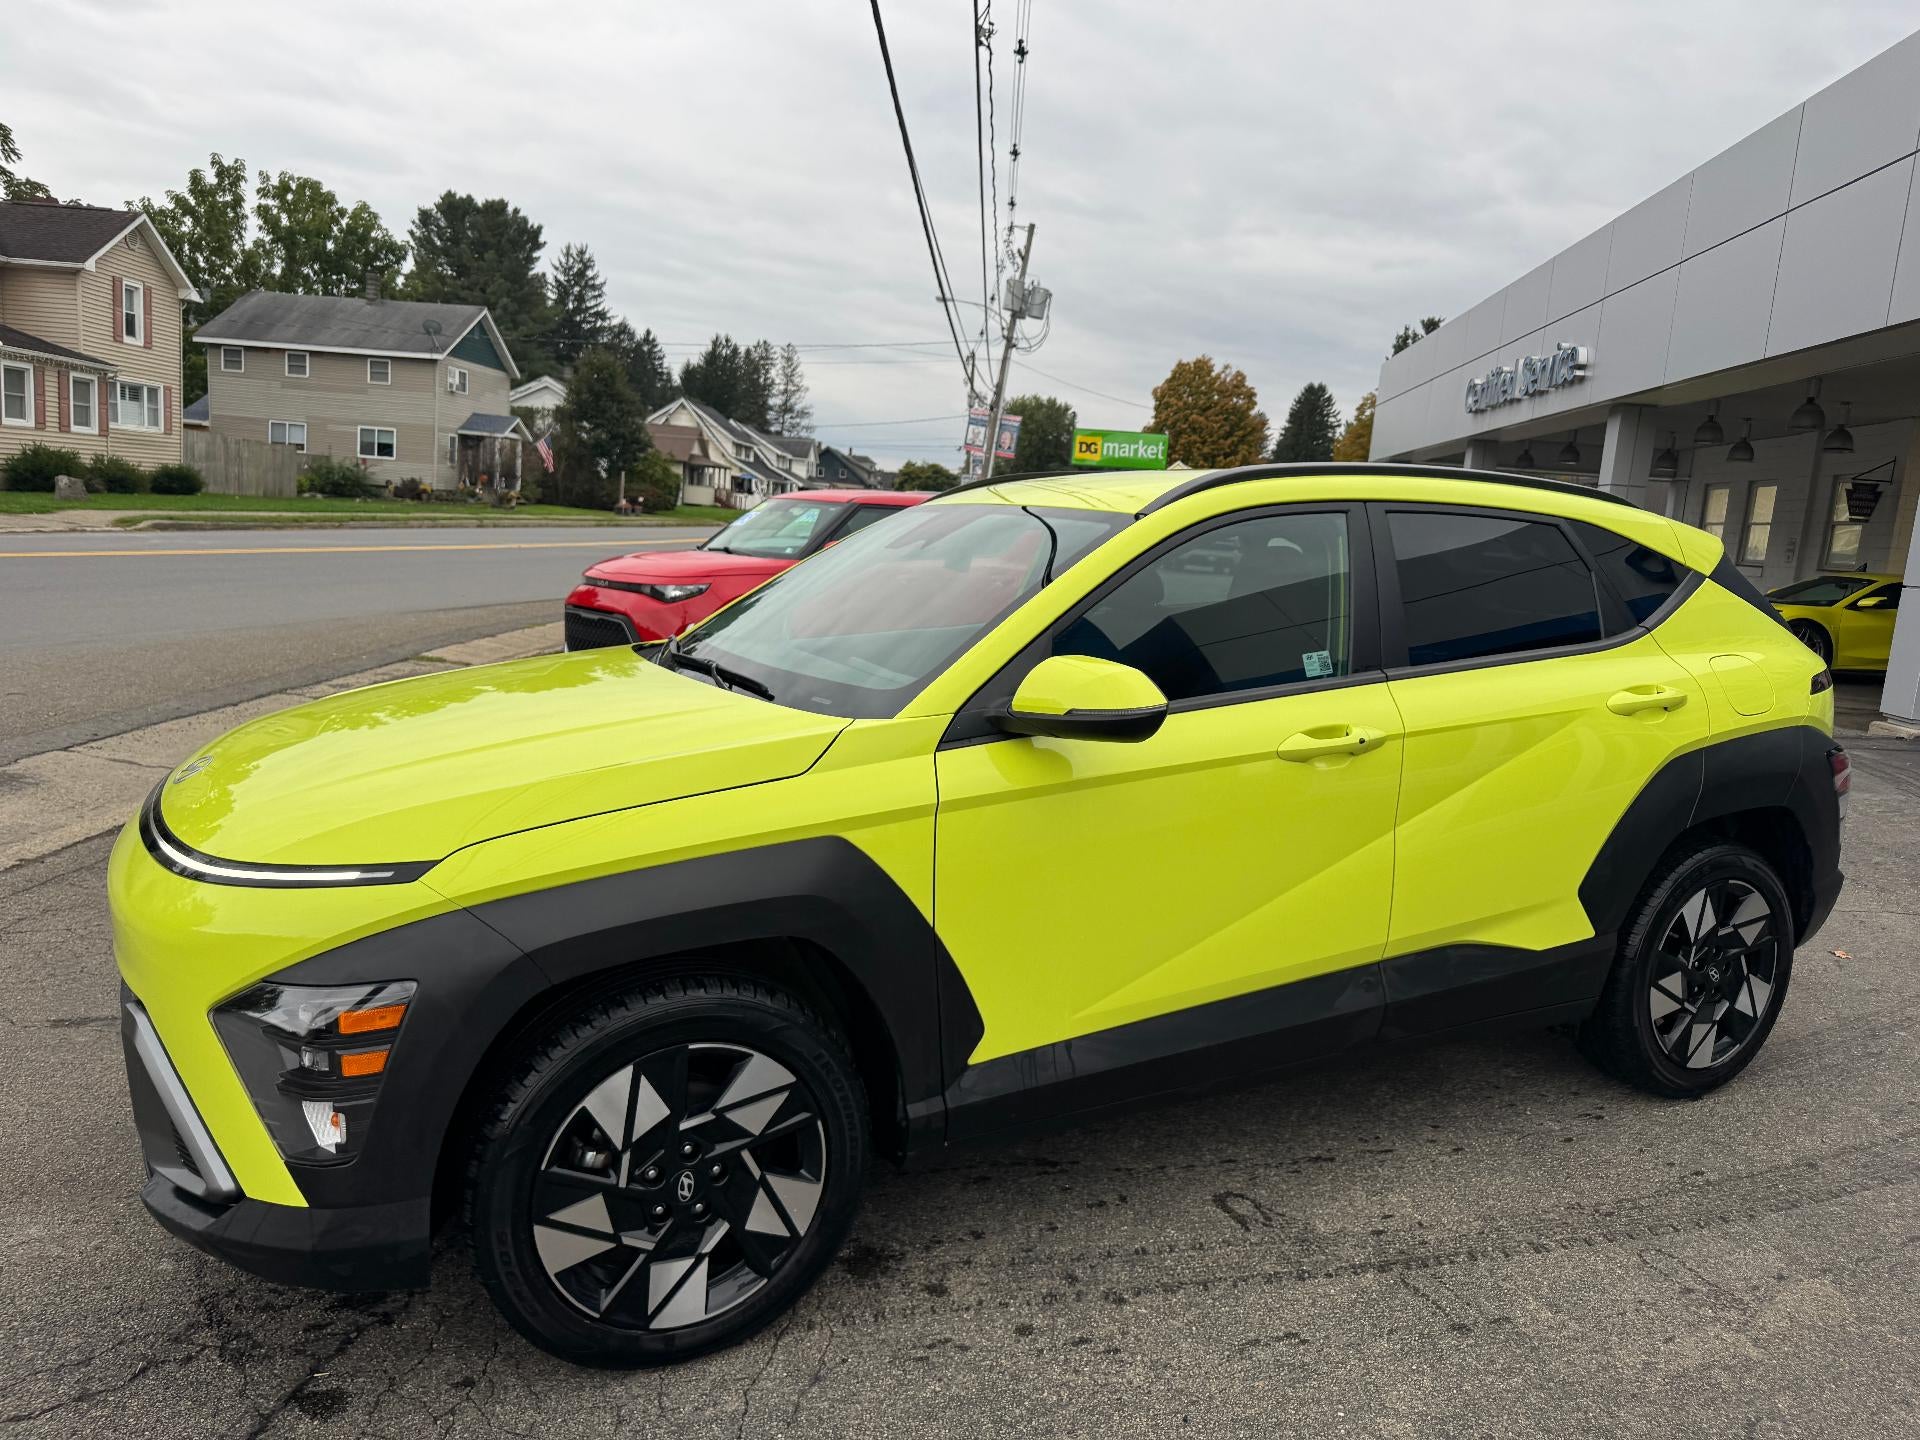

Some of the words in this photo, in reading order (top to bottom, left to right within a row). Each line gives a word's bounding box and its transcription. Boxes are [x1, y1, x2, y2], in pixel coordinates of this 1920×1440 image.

[1519, 342, 1583, 397] Service
[1078, 441, 1098, 454] DG
[1102, 439, 1165, 460] market
